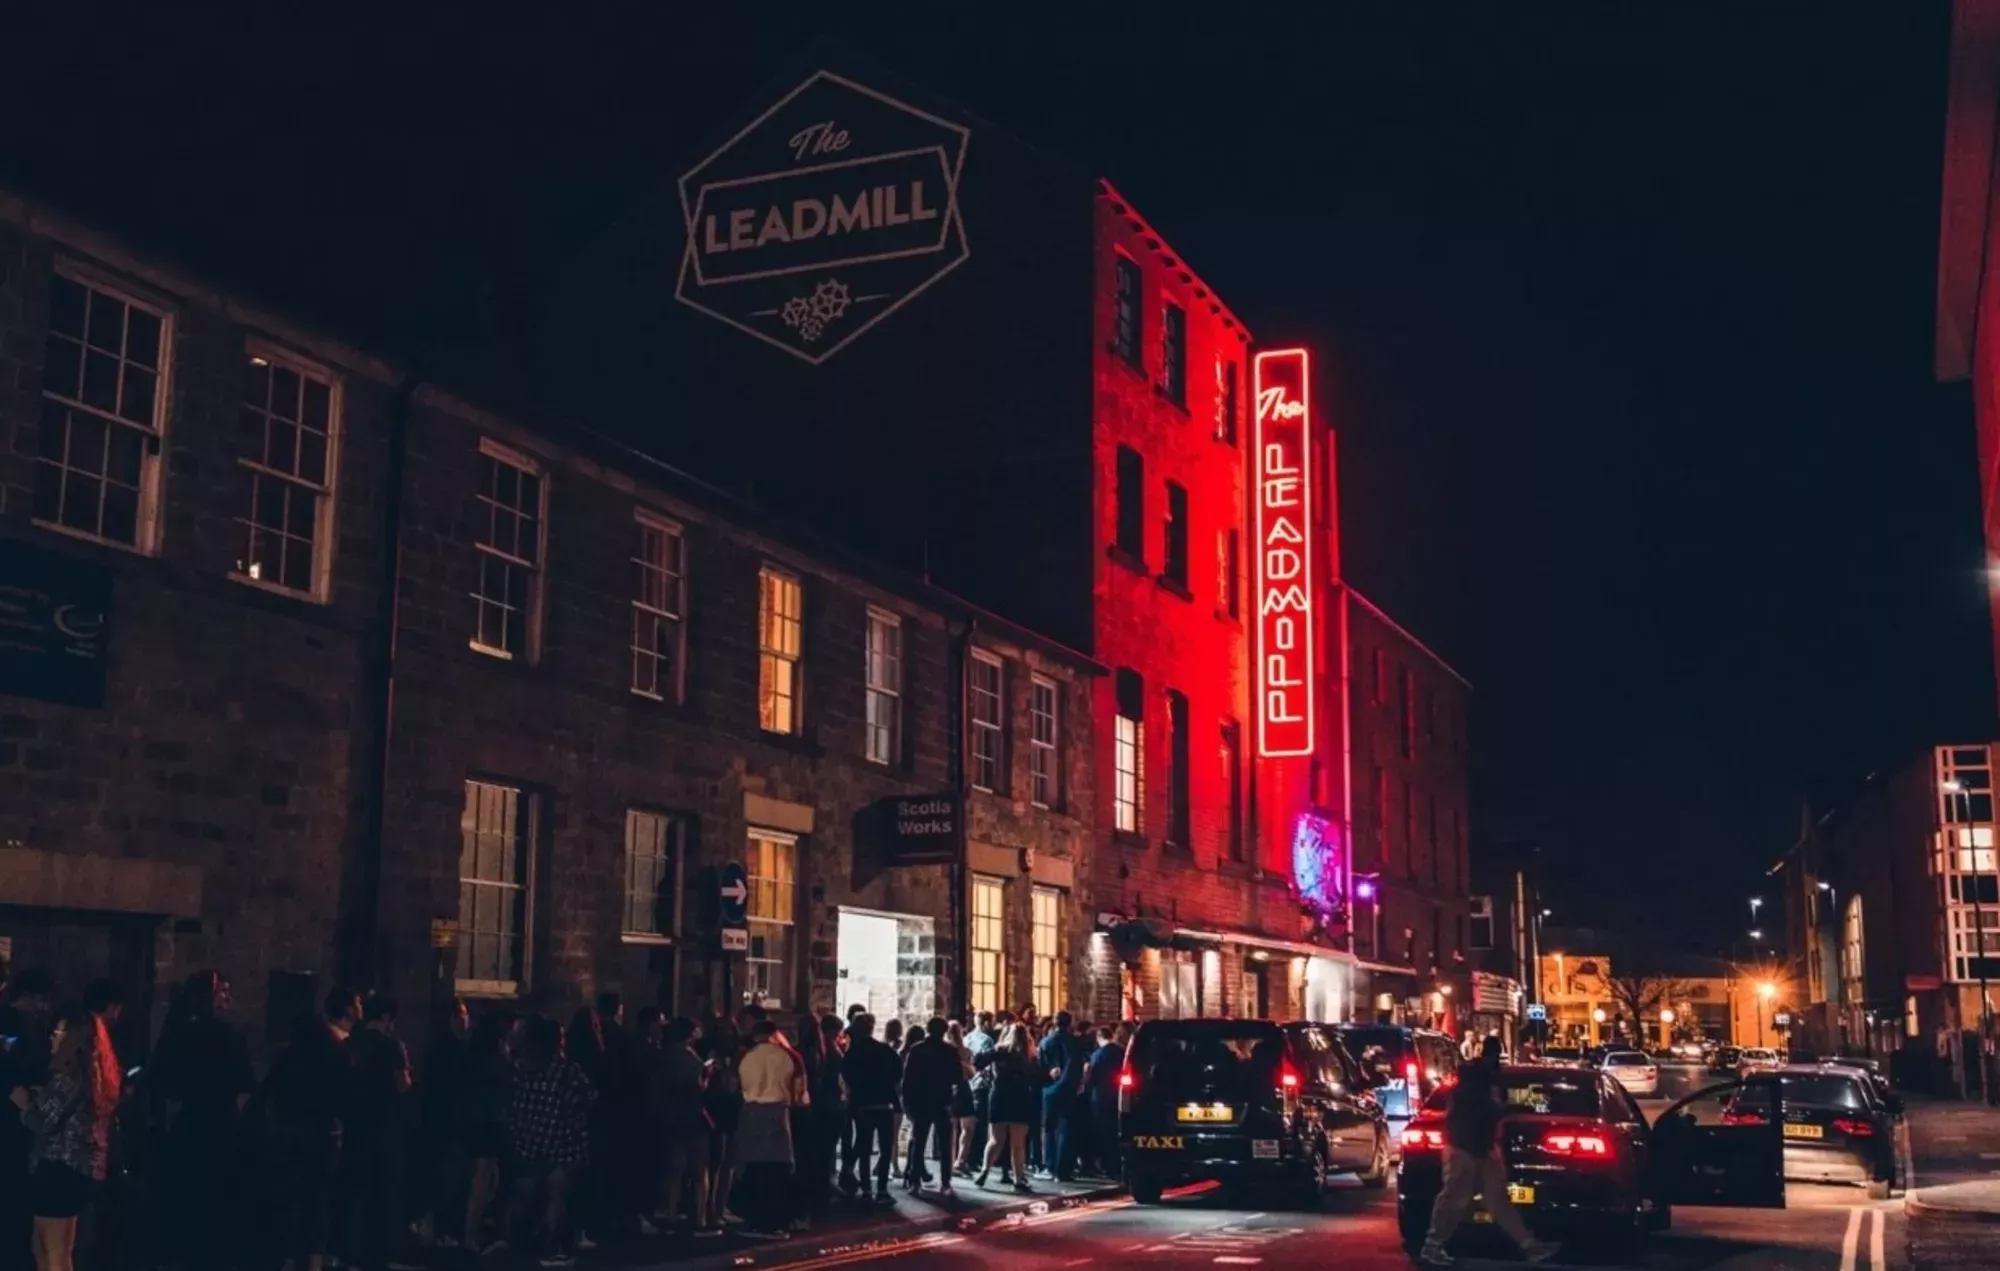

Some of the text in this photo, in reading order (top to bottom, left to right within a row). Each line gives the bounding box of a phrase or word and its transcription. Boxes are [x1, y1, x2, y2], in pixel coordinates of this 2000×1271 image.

[788, 121, 851, 160] The
[705, 181, 937, 254] LEADMILL
[1258, 387, 1305, 421] The
[1263, 443, 1308, 723] LEADMILL
[898, 800, 951, 816] Scotia
[897, 820, 952, 835] Works
[1133, 1136, 1185, 1149] TAXI
